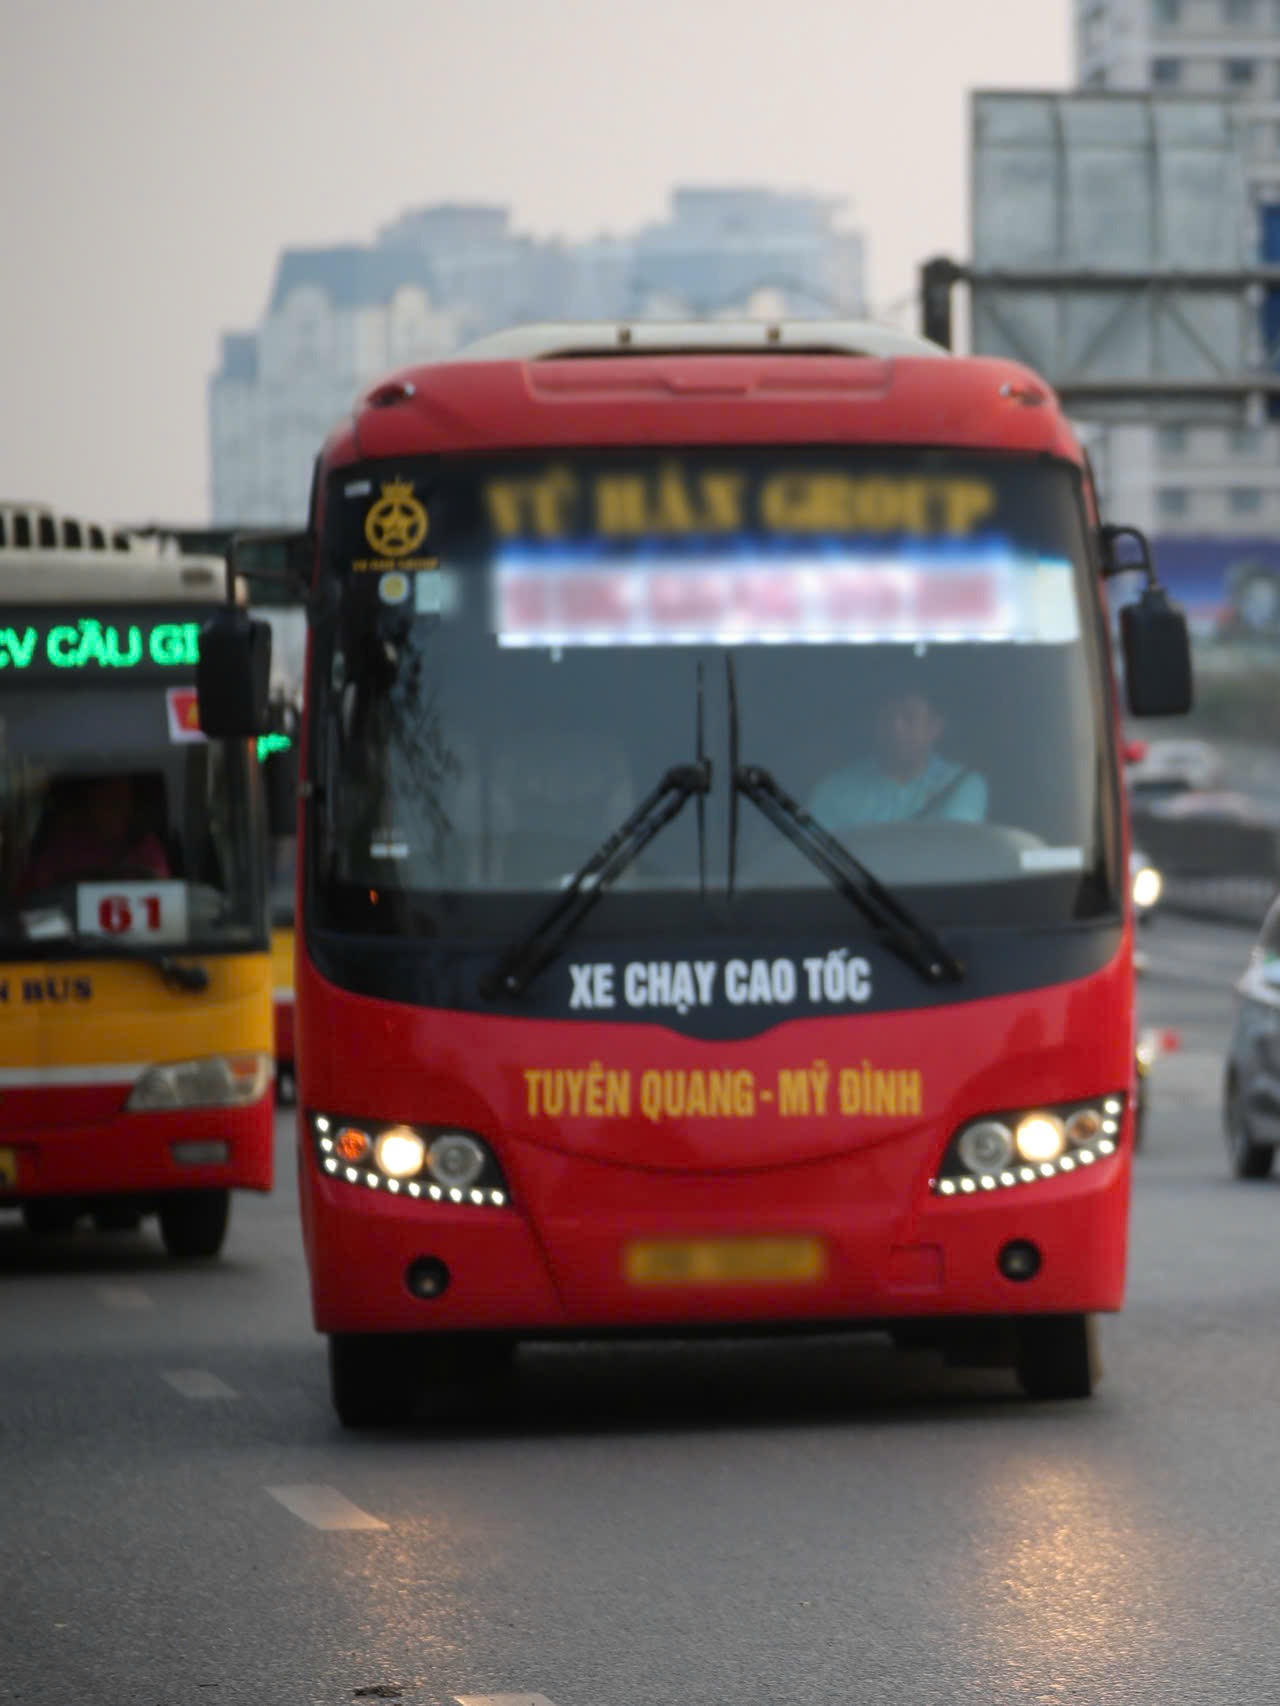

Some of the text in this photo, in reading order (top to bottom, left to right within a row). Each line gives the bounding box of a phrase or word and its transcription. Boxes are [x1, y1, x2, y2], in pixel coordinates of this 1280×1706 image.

[98, 894, 163, 936] 61
[22, 976, 93, 1003] BUS
[568, 948, 872, 1016] XE CHẠY CAO TỐC
[523, 1059, 631, 1118] TUYÊN
[639, 1068, 756, 1122] QUANG
[777, 1059, 829, 1118] MỸ
[838, 1058, 922, 1117] ĐÌNH
